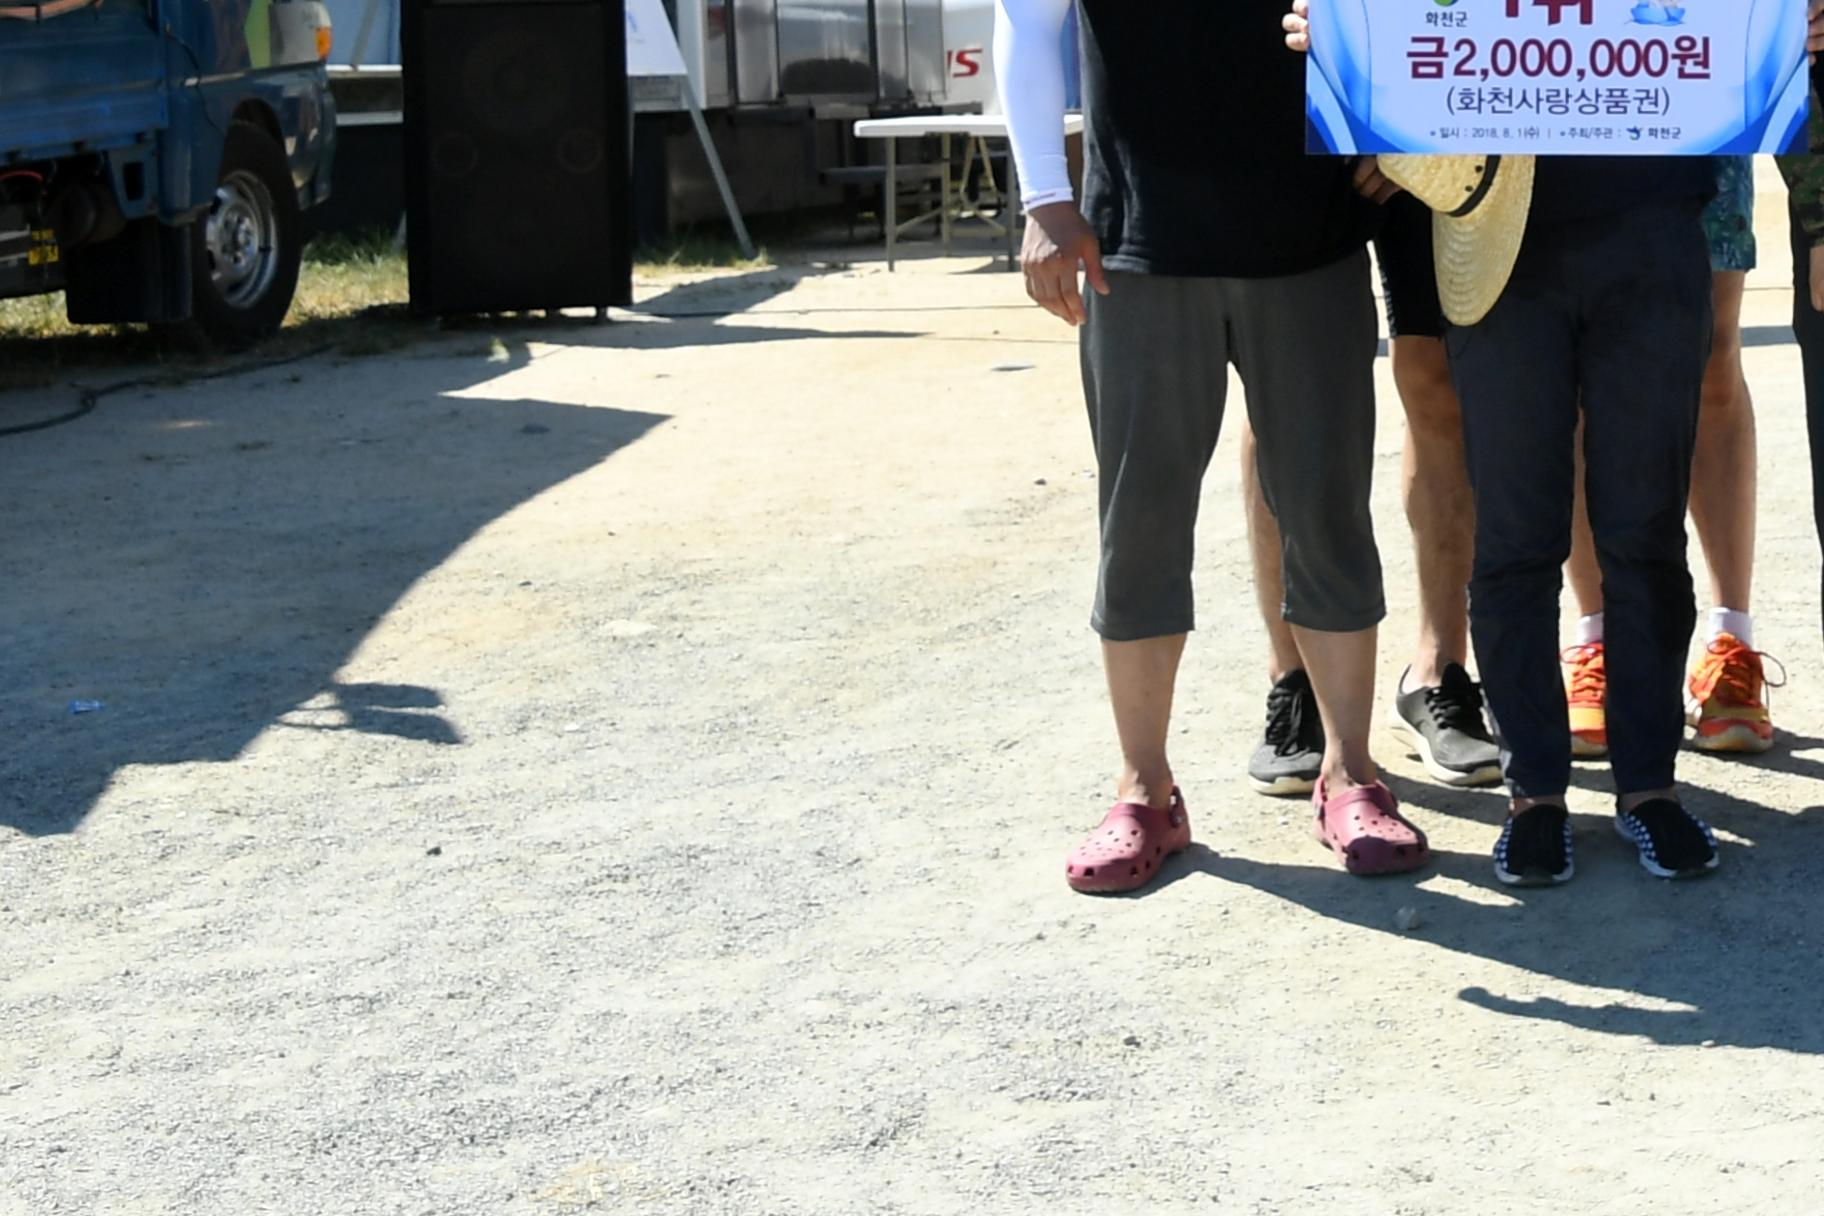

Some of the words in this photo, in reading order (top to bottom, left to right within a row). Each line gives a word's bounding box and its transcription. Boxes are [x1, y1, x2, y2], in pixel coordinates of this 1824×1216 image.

[1426, 12, 1467, 27] 화천군
[1407, 36, 1710, 82] 금2,000,000원
[1447, 87, 1669, 115] (화천사랑상품권)
[1648, 128, 1681, 139] 화천군
